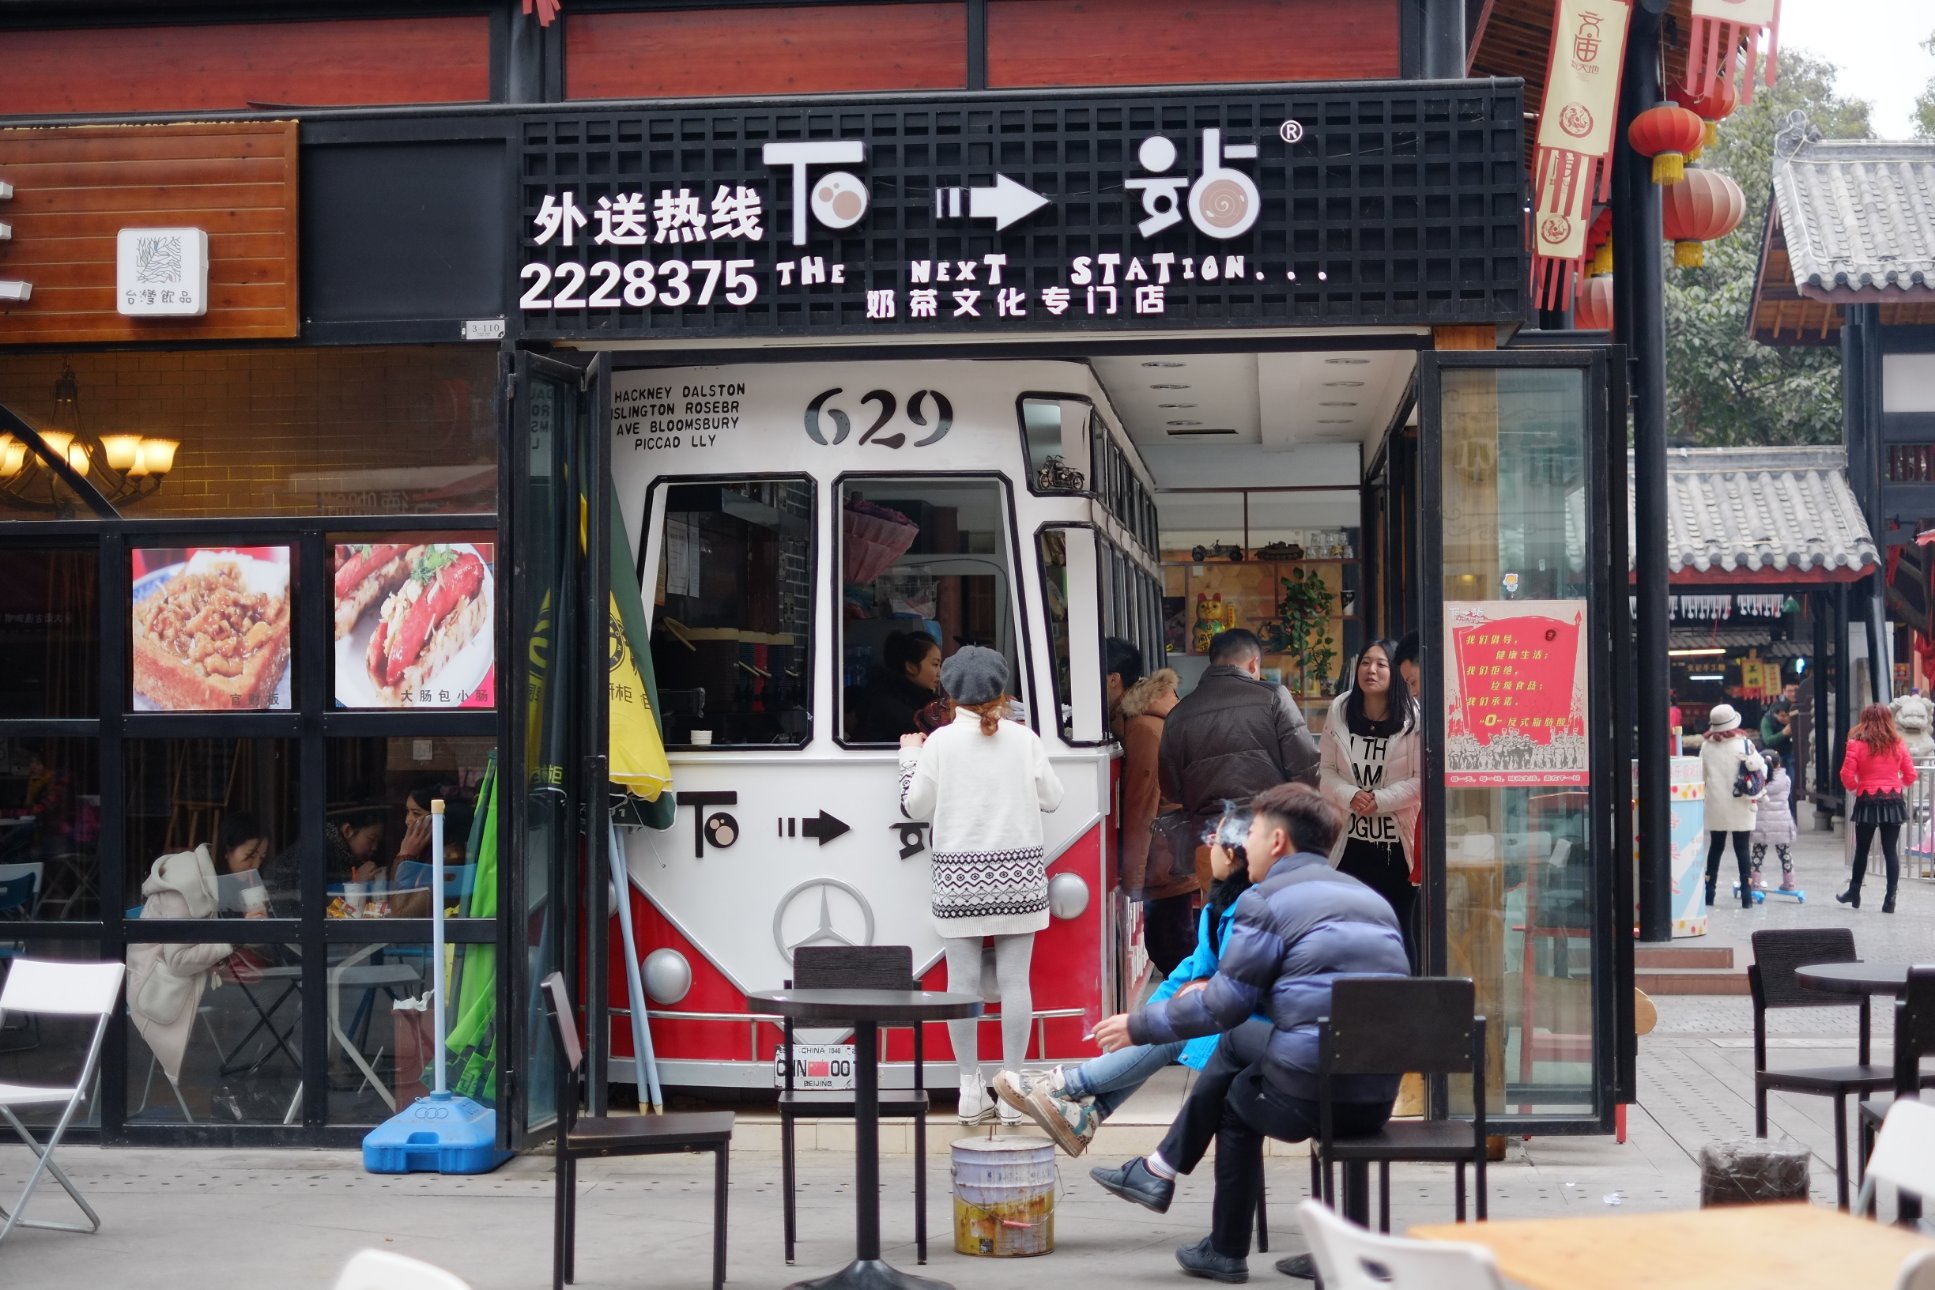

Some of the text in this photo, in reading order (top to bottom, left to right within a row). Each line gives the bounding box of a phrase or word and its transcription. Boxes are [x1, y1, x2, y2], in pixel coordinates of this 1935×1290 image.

[534, 185, 763, 246] 外送热线
[520, 260, 758, 309] 2228375
[776, 256, 845, 286] THE
[911, 253, 1006, 285] NEXT
[867, 285, 1164, 318] 奶茶文化专门店
[614, 383, 745, 403] HACKNEY DALSTON
[685, 401, 739, 415] ROSEBR
[616, 416, 739, 436] AVE BLOOMSBURY
[805, 387, 953, 450] 629
[401, 689, 488, 703] 大肠包小肠
